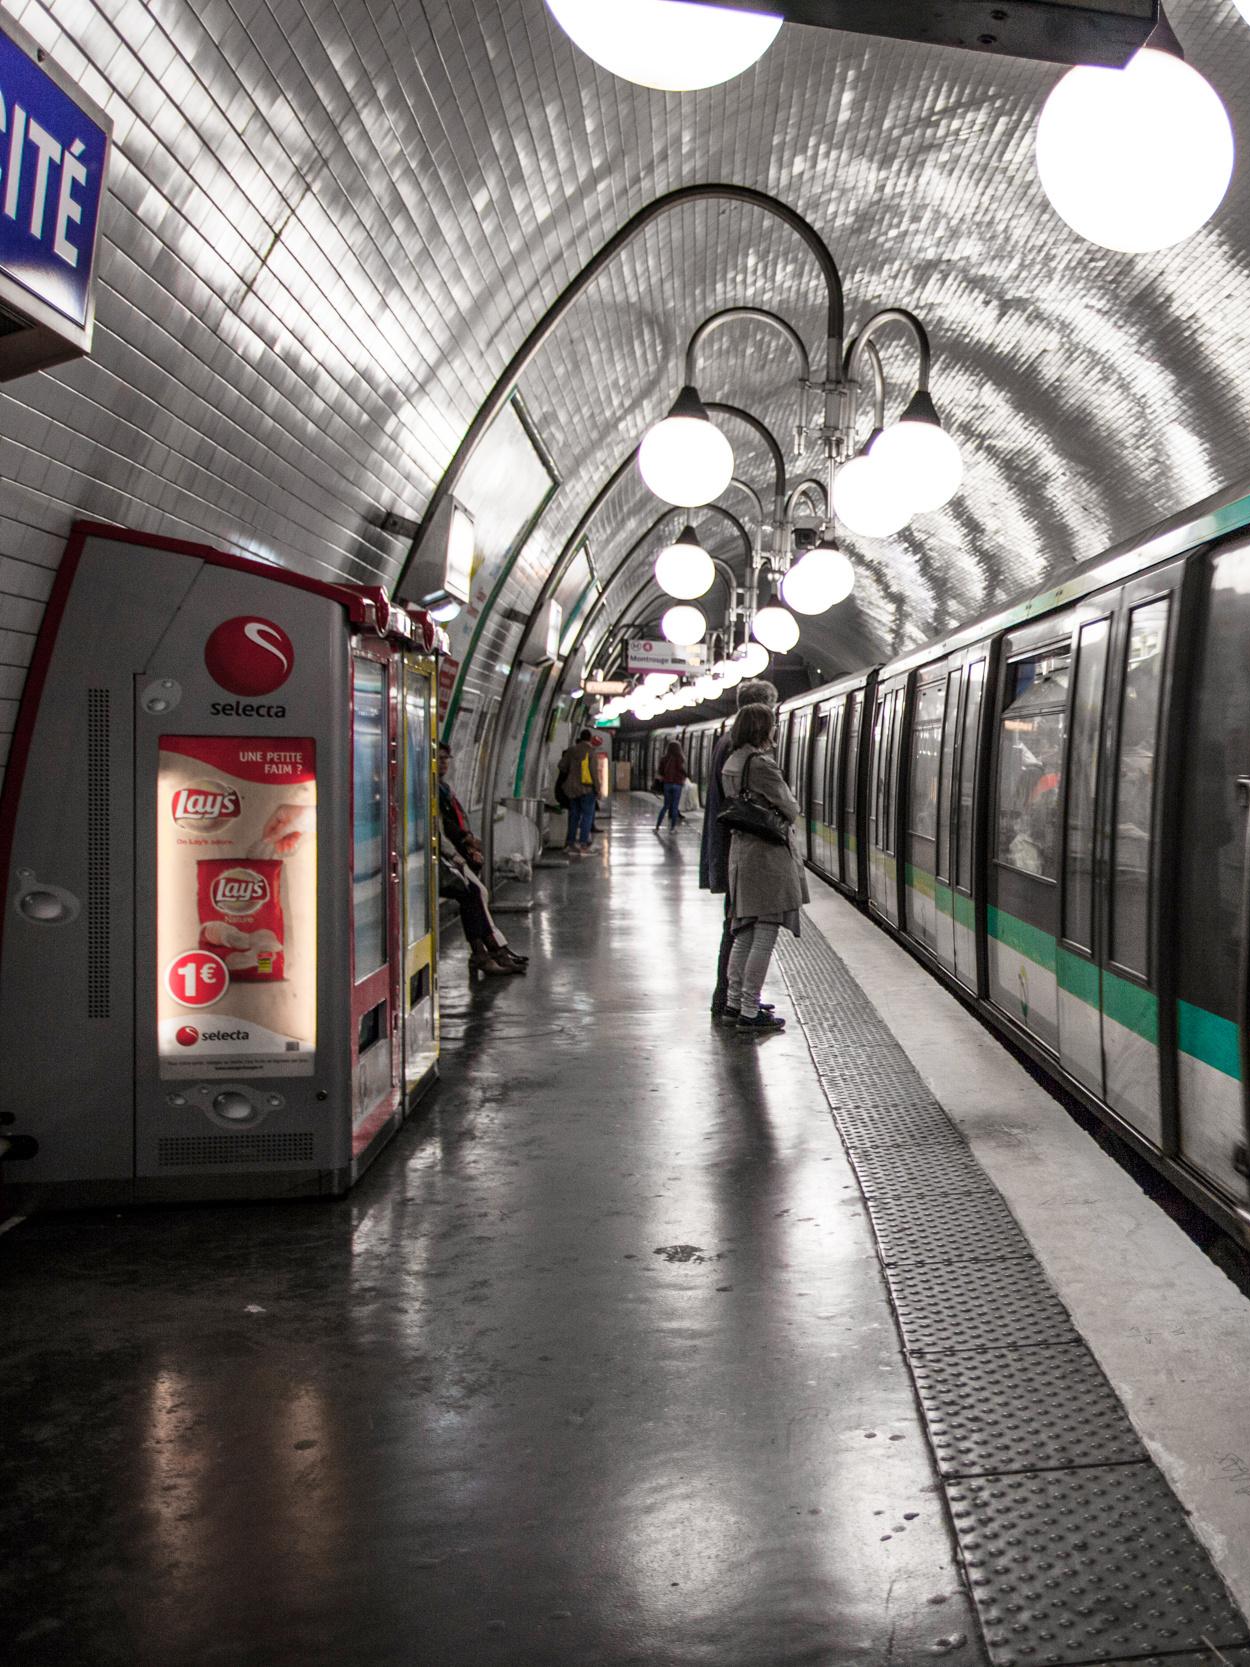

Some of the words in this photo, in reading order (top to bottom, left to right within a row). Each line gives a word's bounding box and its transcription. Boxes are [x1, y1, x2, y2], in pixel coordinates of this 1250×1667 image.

[0, 86, 88, 268] ITÉ
[630, 655, 669, 665] Montrouge
[210, 701, 287, 719] selecta
[239, 751, 263, 763] UNE
[266, 752, 303, 763] PETITE
[264, 763, 293, 775] FAIM
[296, 764, 303, 775] ?
[175, 787, 236, 819] Lay's
[215, 877, 265, 902] Lay's
[177, 962, 217, 998] 1€
[201, 1029, 250, 1041] selecta
